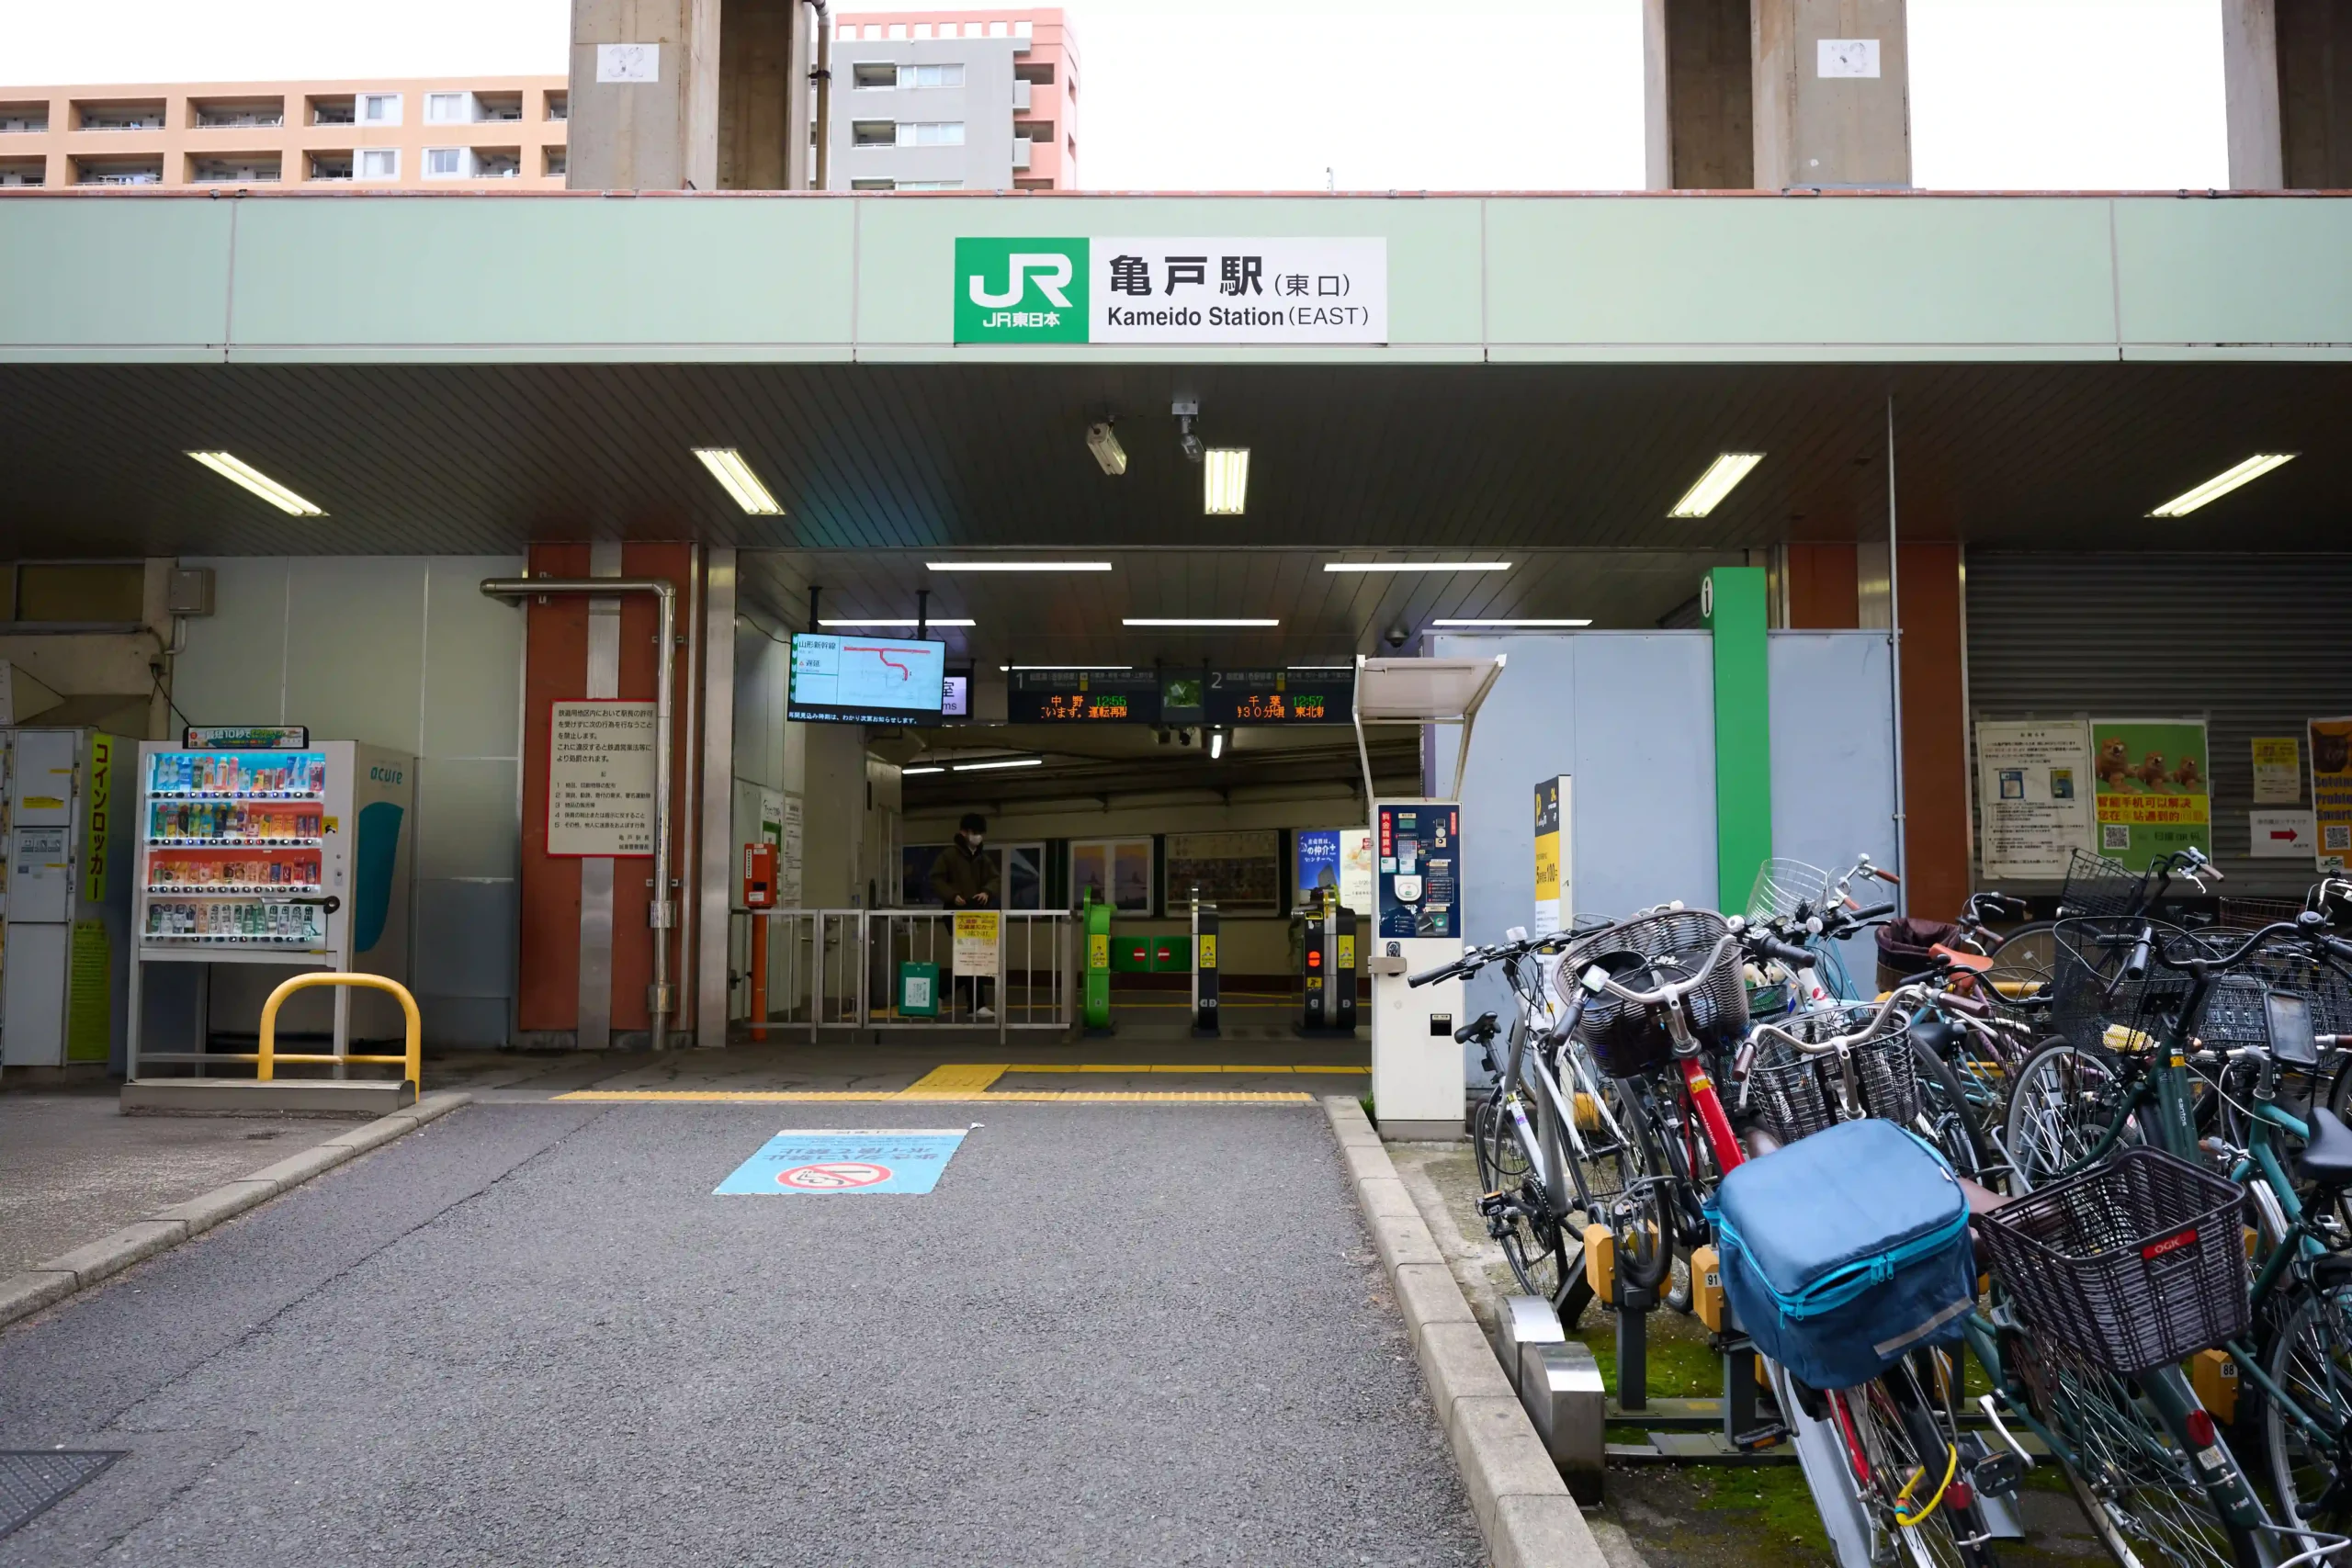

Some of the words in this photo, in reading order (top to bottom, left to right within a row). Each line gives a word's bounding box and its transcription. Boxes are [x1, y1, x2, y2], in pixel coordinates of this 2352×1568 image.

[969, 254, 1073, 308] JR
[983, 311, 1060, 328] JR東日本
[1108, 306, 1201, 326] Kameido
[799, 640, 836, 649] 山形新幹線
[1015, 672, 1023, 689] 1
[1211, 671, 1222, 689] 2
[1096, 695, 1127, 706] 12:55
[1293, 695, 1323, 706] 12:57
[370, 766, 402, 785] acure
[90, 743, 108, 899] コインロッカー
[2154, 1235, 2180, 1254] OGK
[1707, 1274, 1718, 1286] 91
[2223, 1364, 2234, 1376] 88
